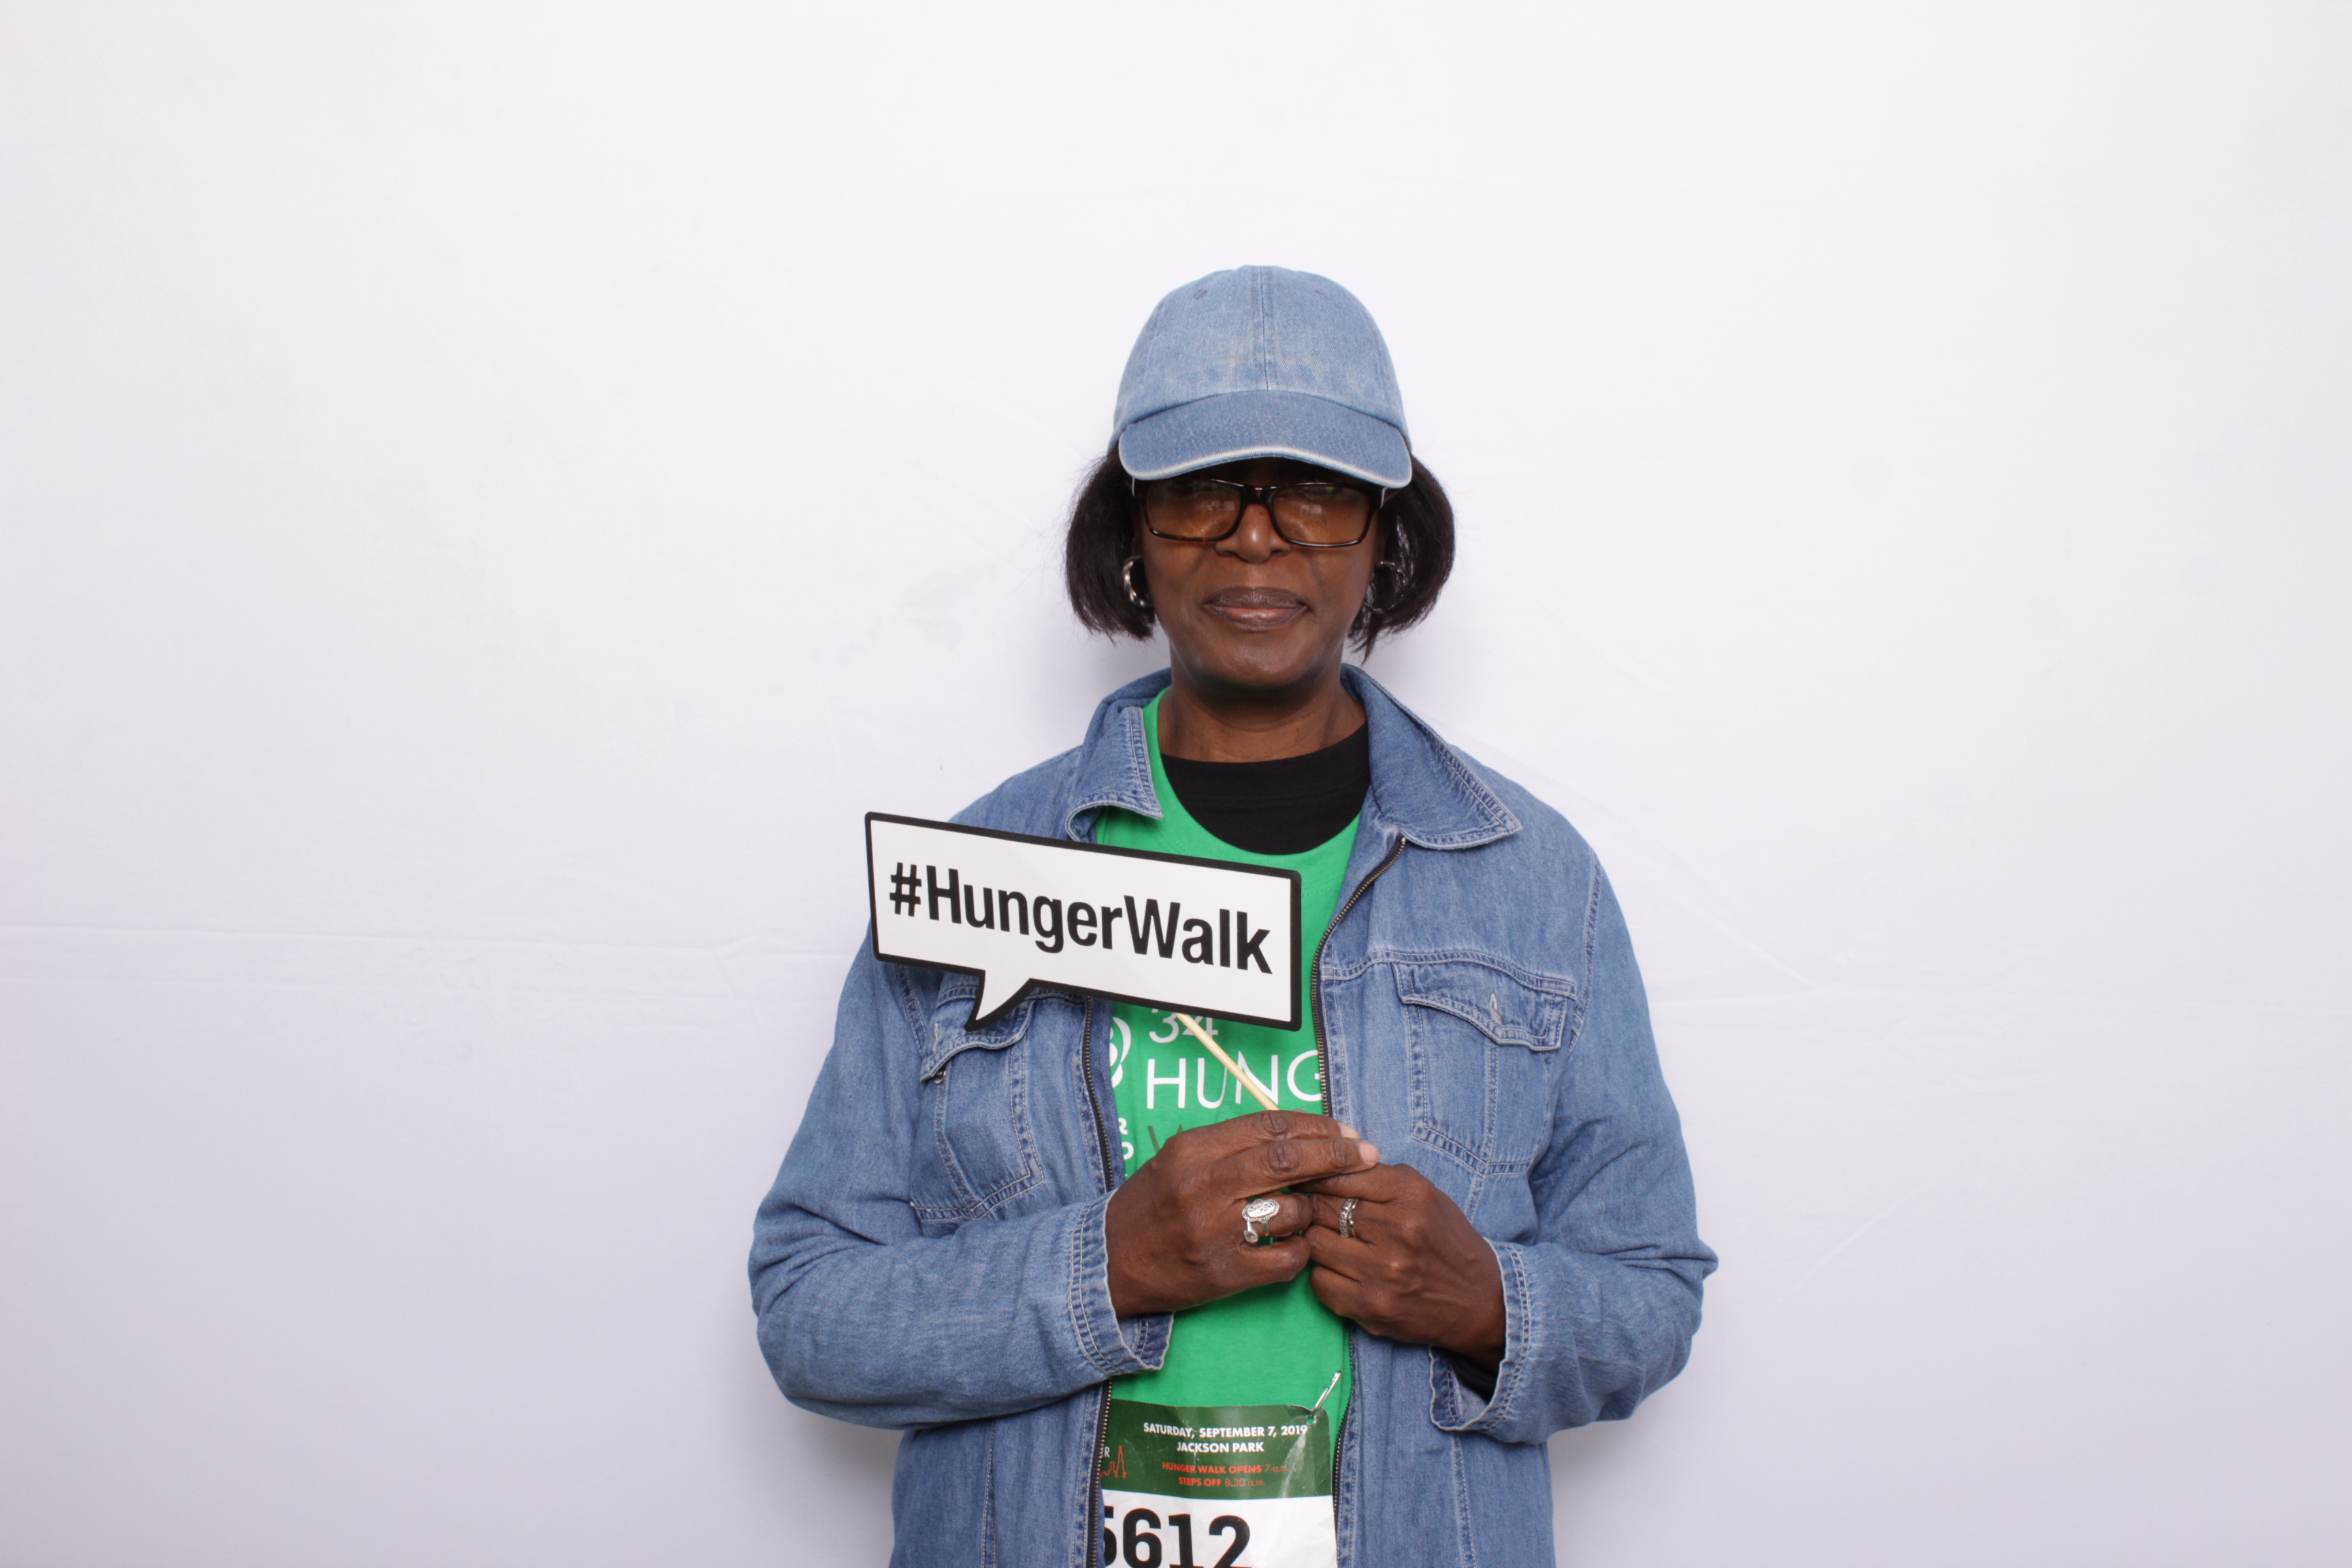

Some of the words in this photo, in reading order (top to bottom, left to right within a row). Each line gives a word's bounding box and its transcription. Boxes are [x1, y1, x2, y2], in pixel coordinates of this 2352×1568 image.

[889, 862, 1272, 975] #HungerWalk
[1143, 1422, 1195, 1439] SATURDAY,
[1199, 1426, 1264, 1438] SEPTEMBER
[1267, 1426, 1277, 1437] 7,
[1281, 1424, 1308, 1436] 2019
[1177, 1441, 1229, 1453] JACKSON
[1232, 1441, 1264, 1452] PARK
[1162, 1462, 1196, 1473] HUNGER
[1198, 1465, 1226, 1474] WALK
[1228, 1465, 1262, 1473] OPENS
[1264, 1464, 1271, 1473] 7
[1178, 1477, 1202, 1486] STEPS
[1204, 1478, 1222, 1487] OFF
[1224, 1478, 1245, 1488] 8:30
